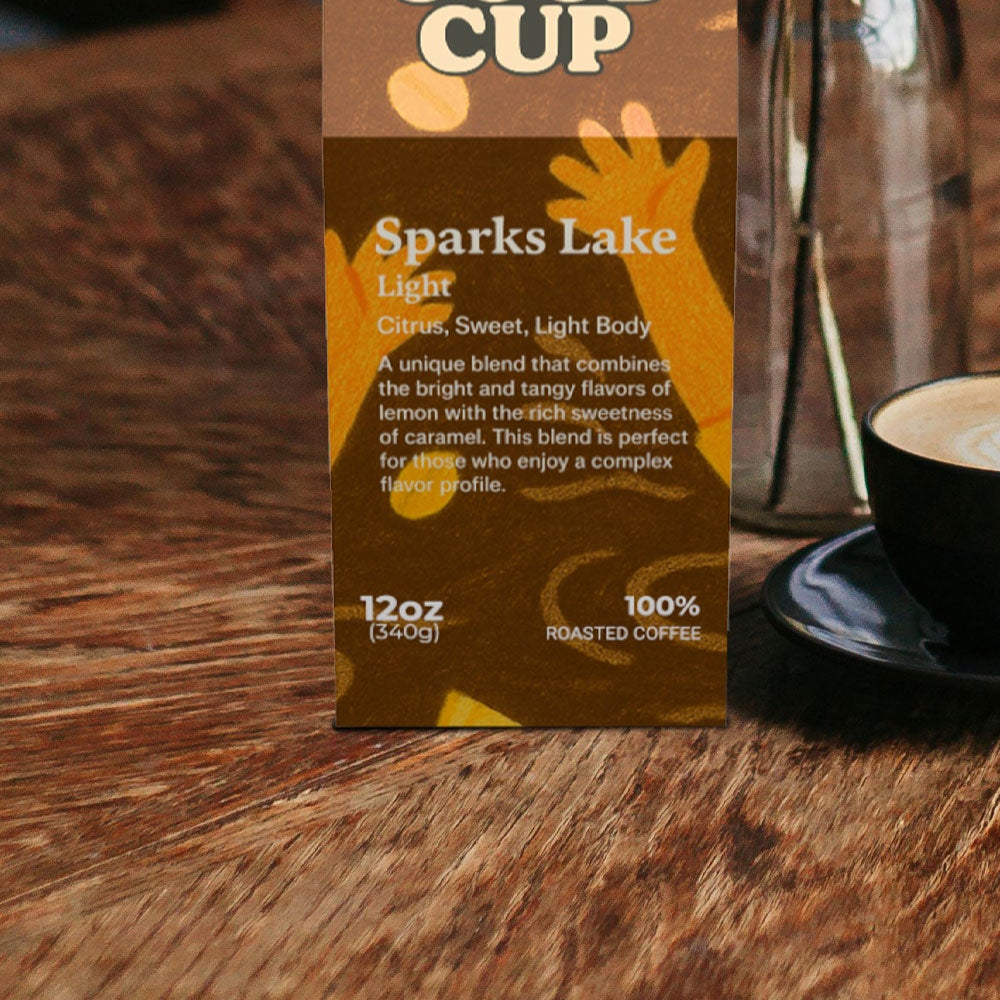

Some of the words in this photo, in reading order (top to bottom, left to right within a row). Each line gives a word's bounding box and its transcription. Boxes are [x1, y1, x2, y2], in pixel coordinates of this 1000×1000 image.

[418, 5, 632, 73] CUP
[375, 215, 546, 266] Sparks
[559, 216, 677, 255] Lake
[377, 274, 452, 304] Light
[377, 316, 450, 337] Citrus,
[455, 316, 529, 337] Sweet,
[535, 316, 589, 339] Light
[596, 316, 652, 339] Body
[378, 355, 393, 372] A
[399, 356, 465, 376] unique
[471, 355, 525, 373] blend
[531, 355, 570, 373] that
[576, 355, 670, 373] combines
[378, 380, 410, 397] the
[416, 380, 473, 400] bright
[478, 380, 515, 397] and
[520, 381, 575, 401] tangy
[581, 379, 646, 397] flavors
[651, 380, 671, 397] of
[379, 404, 438, 421] lemon
[445, 404, 486, 421] with
[492, 404, 522, 421] the
[529, 404, 566, 421] rich
[571, 406, 673, 421] sweetness
[379, 428, 398, 445] of
[404, 428, 486, 445] caramel.
[493, 428, 532, 445] This
[538, 428, 592, 445] blend
[597, 428, 613, 445] is
[618, 428, 688, 448] perfect
[380, 452, 407, 469] for
[413, 452, 466, 469] those
[472, 452, 512, 469] who
[517, 452, 569, 473] enjoy
[575, 455, 586, 469] a
[591, 452, 673, 473] complex
[380, 476, 433, 493] flavor
[440, 476, 506, 496] profile.
[360, 595, 444, 622] 12oz
[624, 595, 700, 617] 100%
[369, 623, 440, 644] (340g)
[547, 626, 628, 641] ROASTED
[633, 626, 701, 641] COFFEE
